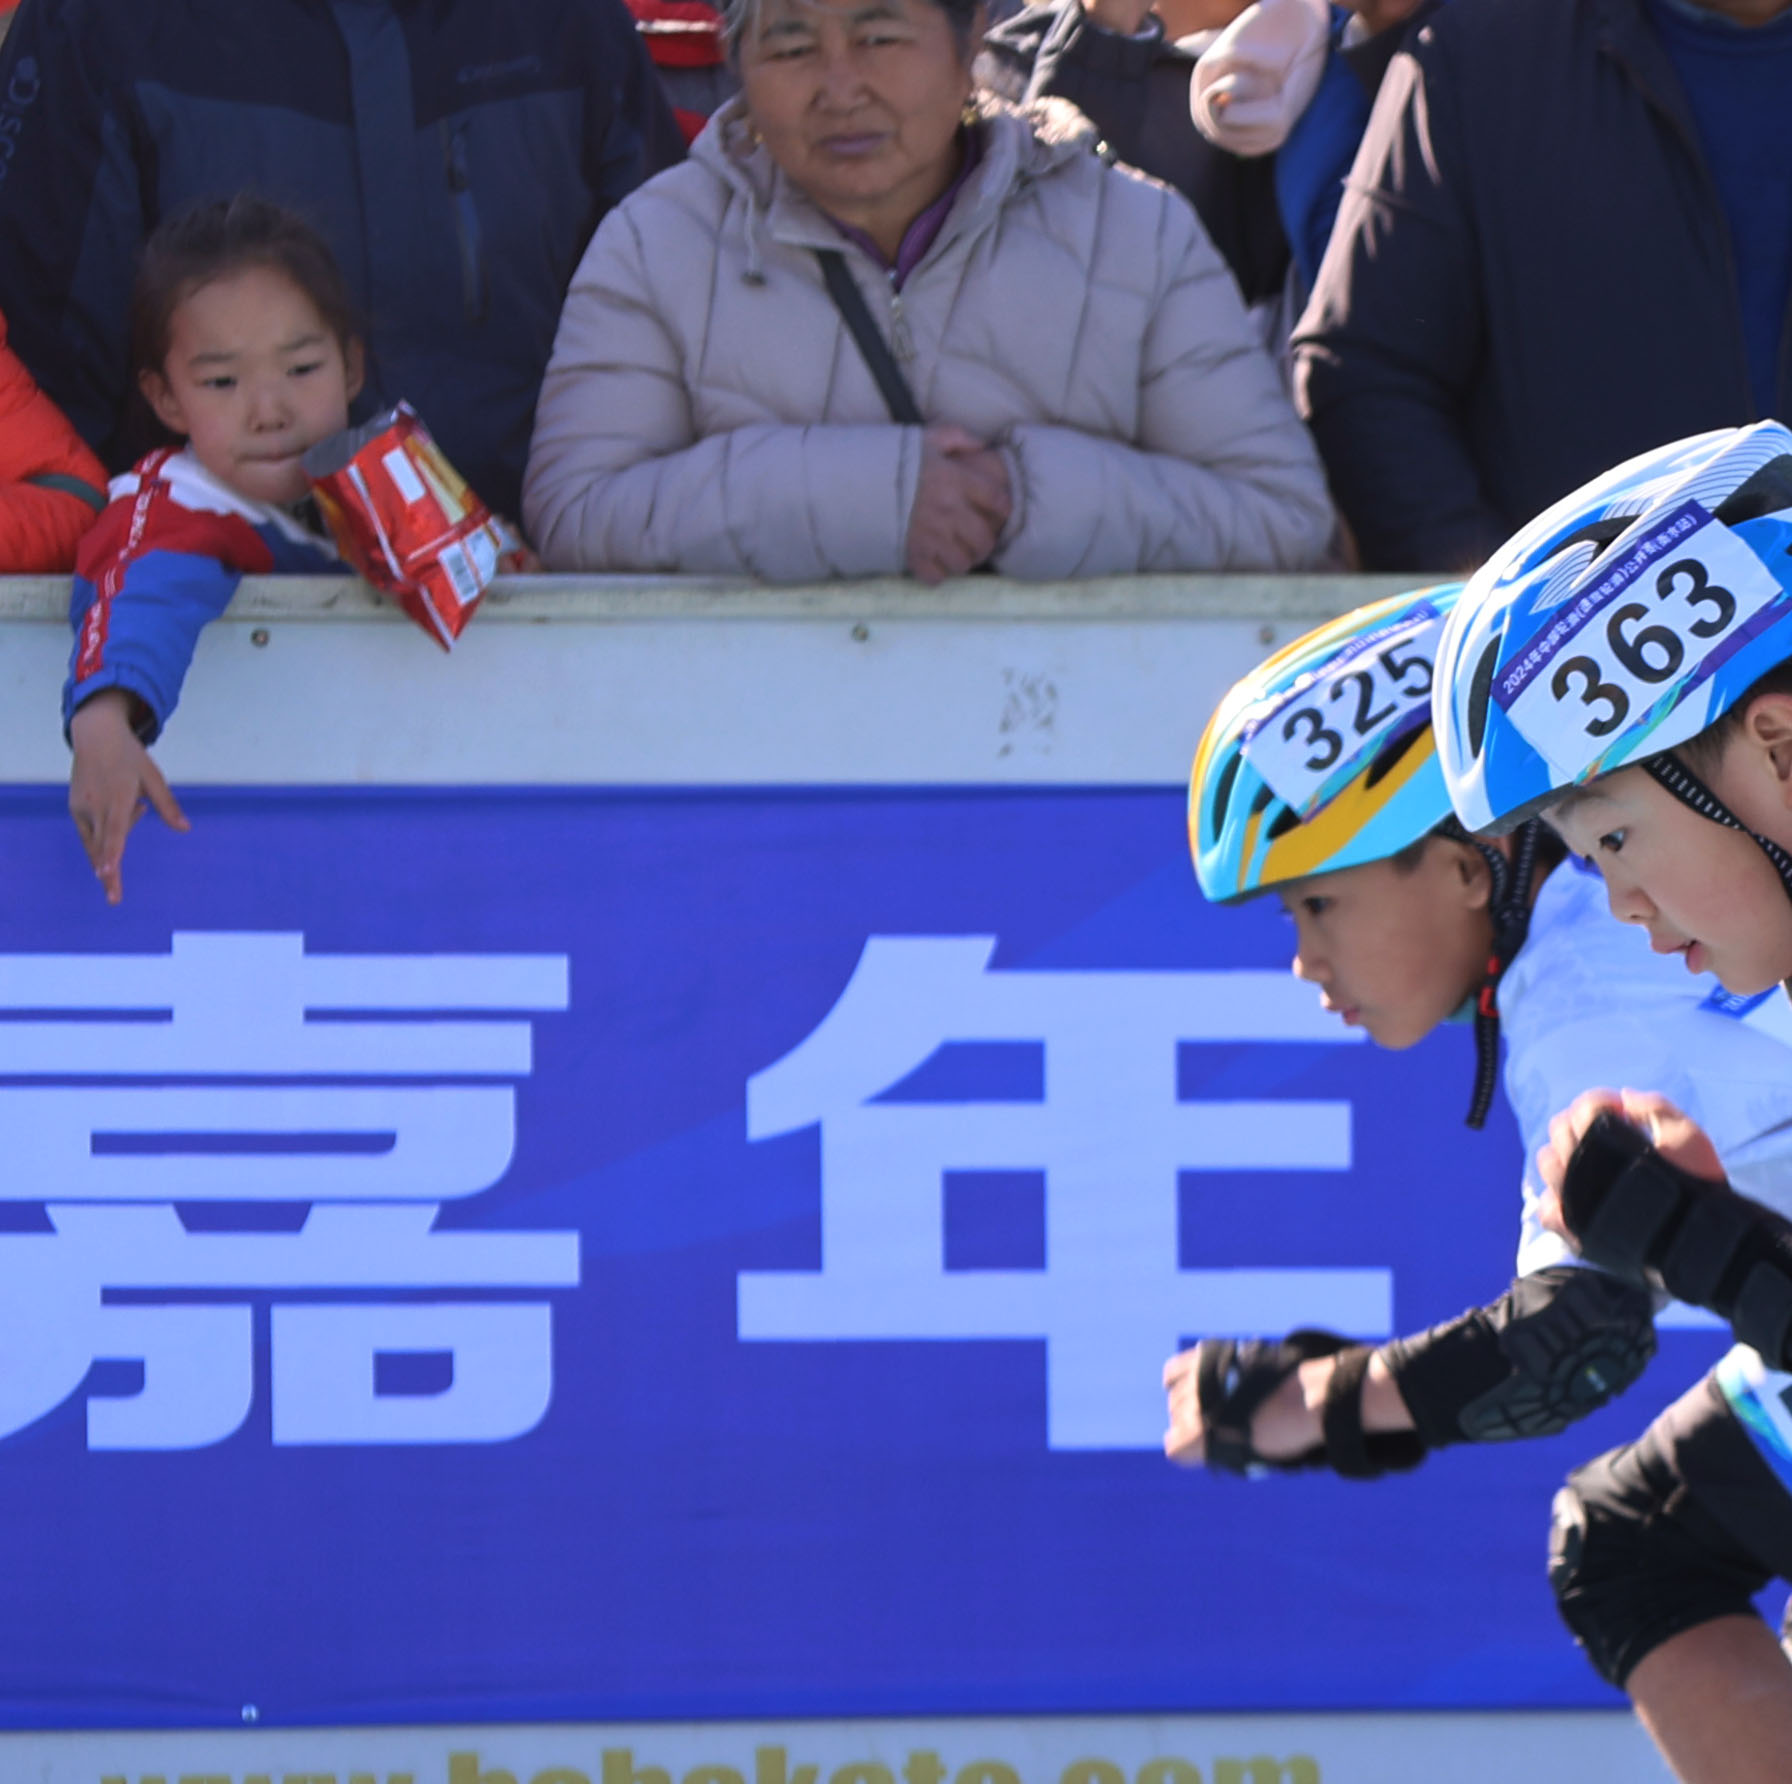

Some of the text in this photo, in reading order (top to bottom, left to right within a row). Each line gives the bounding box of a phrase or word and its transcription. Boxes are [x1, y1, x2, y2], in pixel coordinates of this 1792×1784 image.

[1282, 638, 1434, 772] 325
[1550, 557, 1738, 738] 363
[0, 930, 1394, 1449] 嘉年
